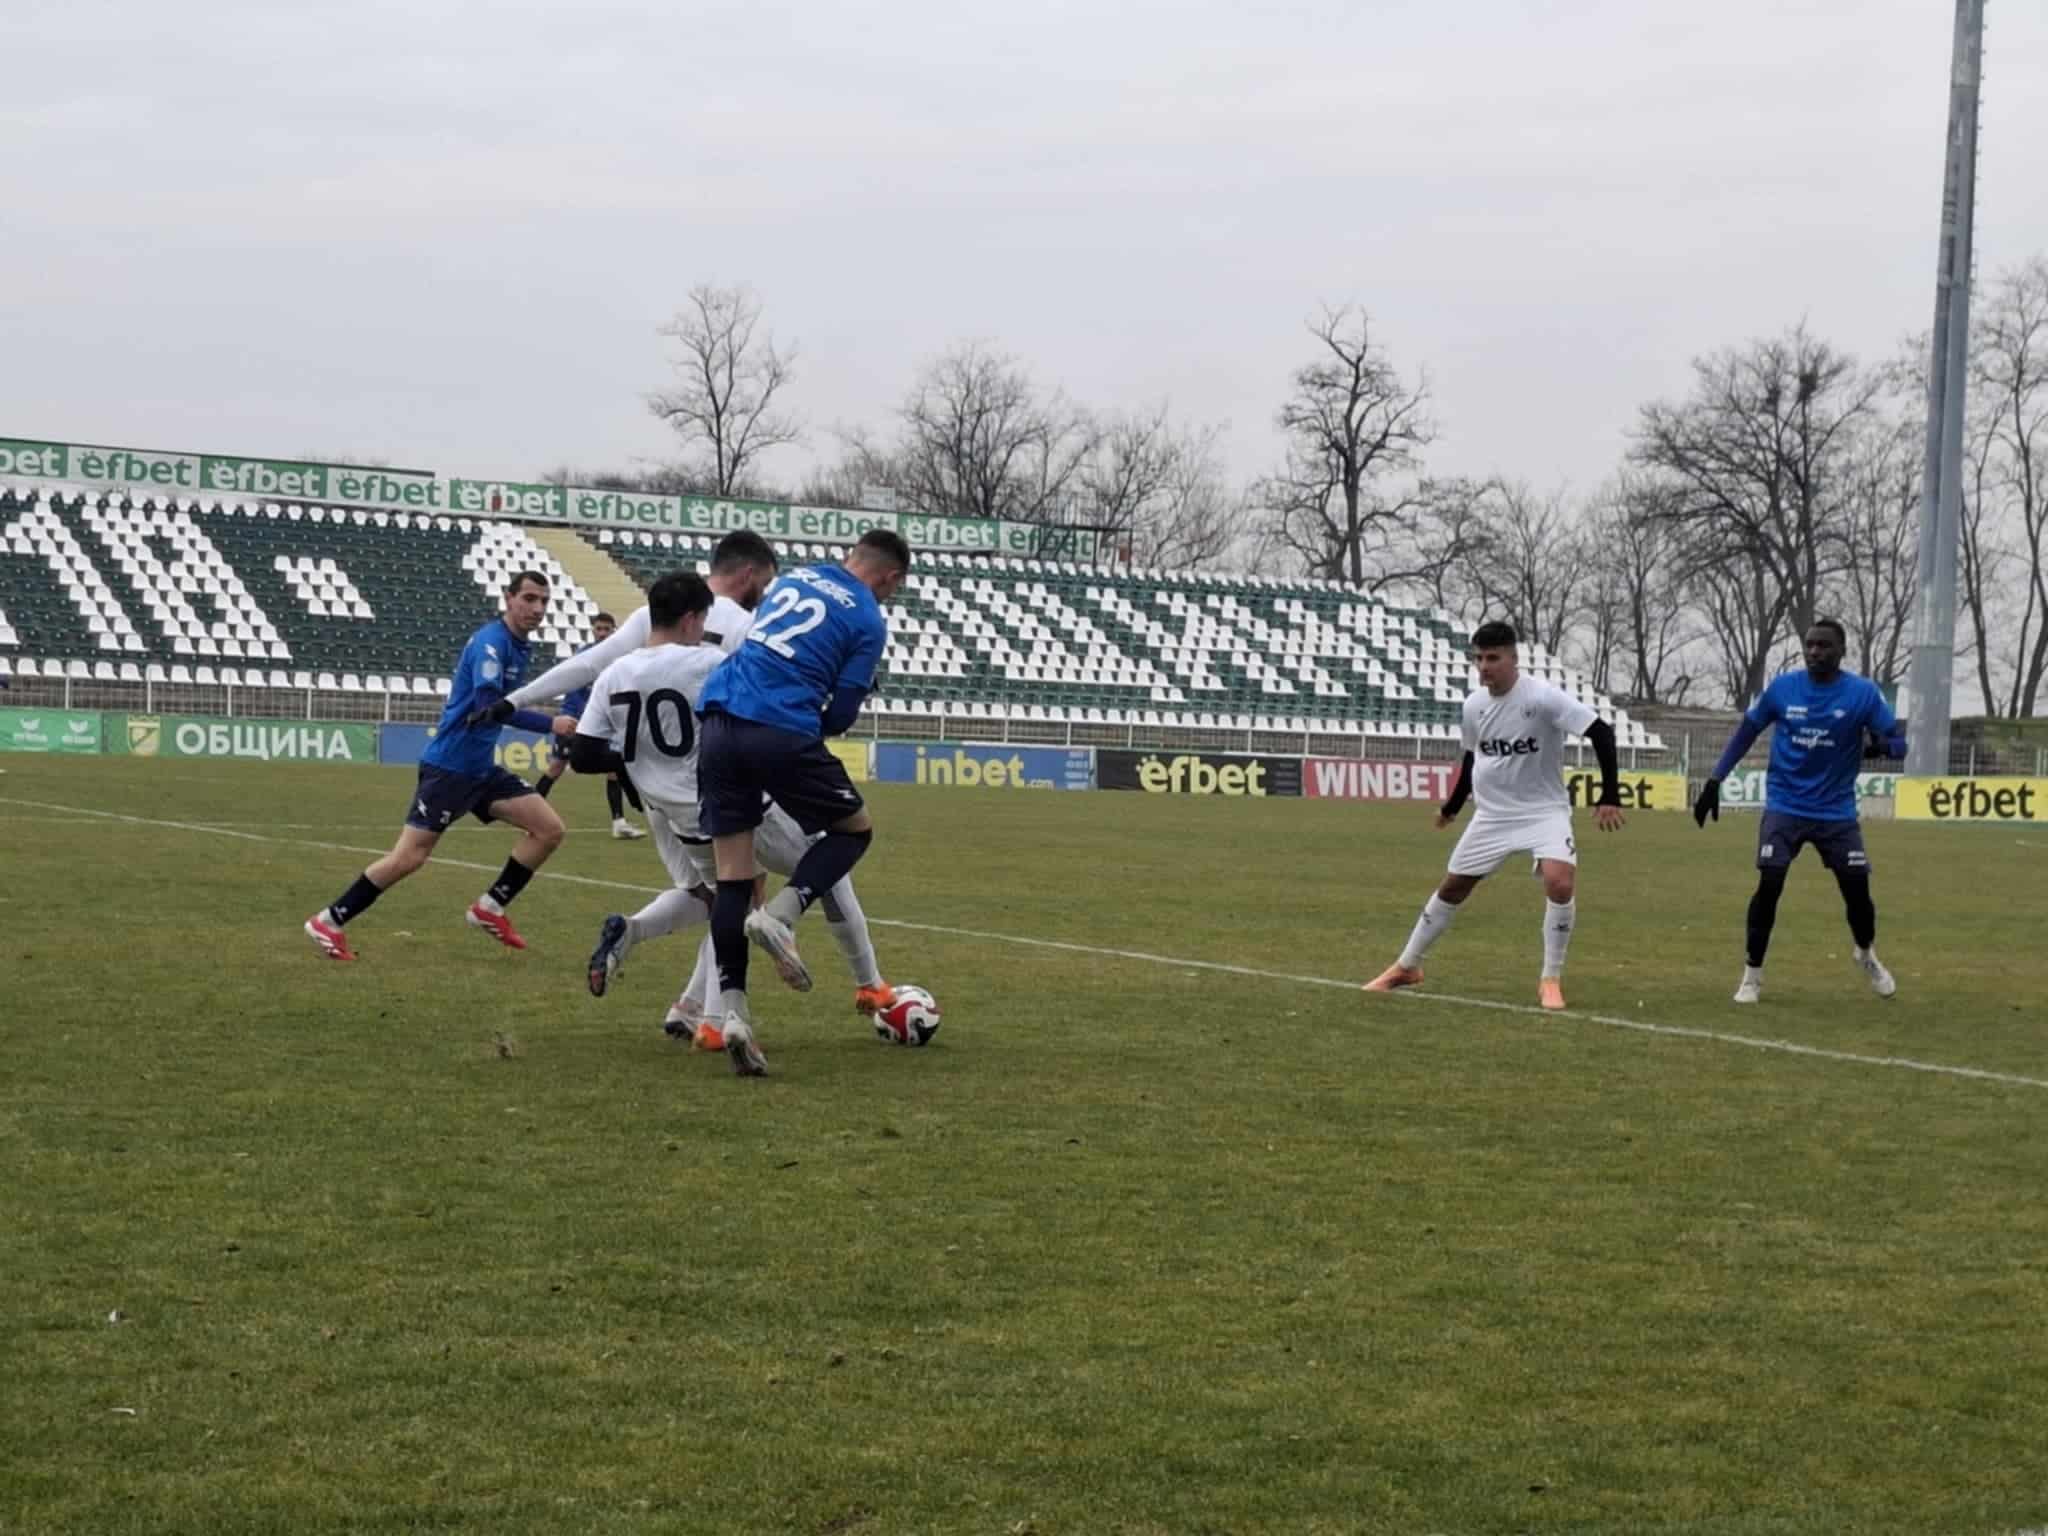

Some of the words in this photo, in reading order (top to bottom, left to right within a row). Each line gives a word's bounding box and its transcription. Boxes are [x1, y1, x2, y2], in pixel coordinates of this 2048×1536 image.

[79, 449, 192, 486] efbet
[209, 460, 321, 497] efbet
[336, 472, 441, 506] efbet
[457, 482, 561, 516] efbet
[576, 485, 673, 524] efbet
[688, 500, 783, 533] efbet
[902, 516, 994, 546] efbet
[747, 587, 826, 659] 22
[175, 722, 353, 761] ОБЩИНА
[609, 688, 695, 763] 70
[494, 734, 553, 772] et
[1136, 755, 1267, 797] efbet
[1314, 761, 1452, 799] WINBET
[1927, 782, 2035, 819] efbet
